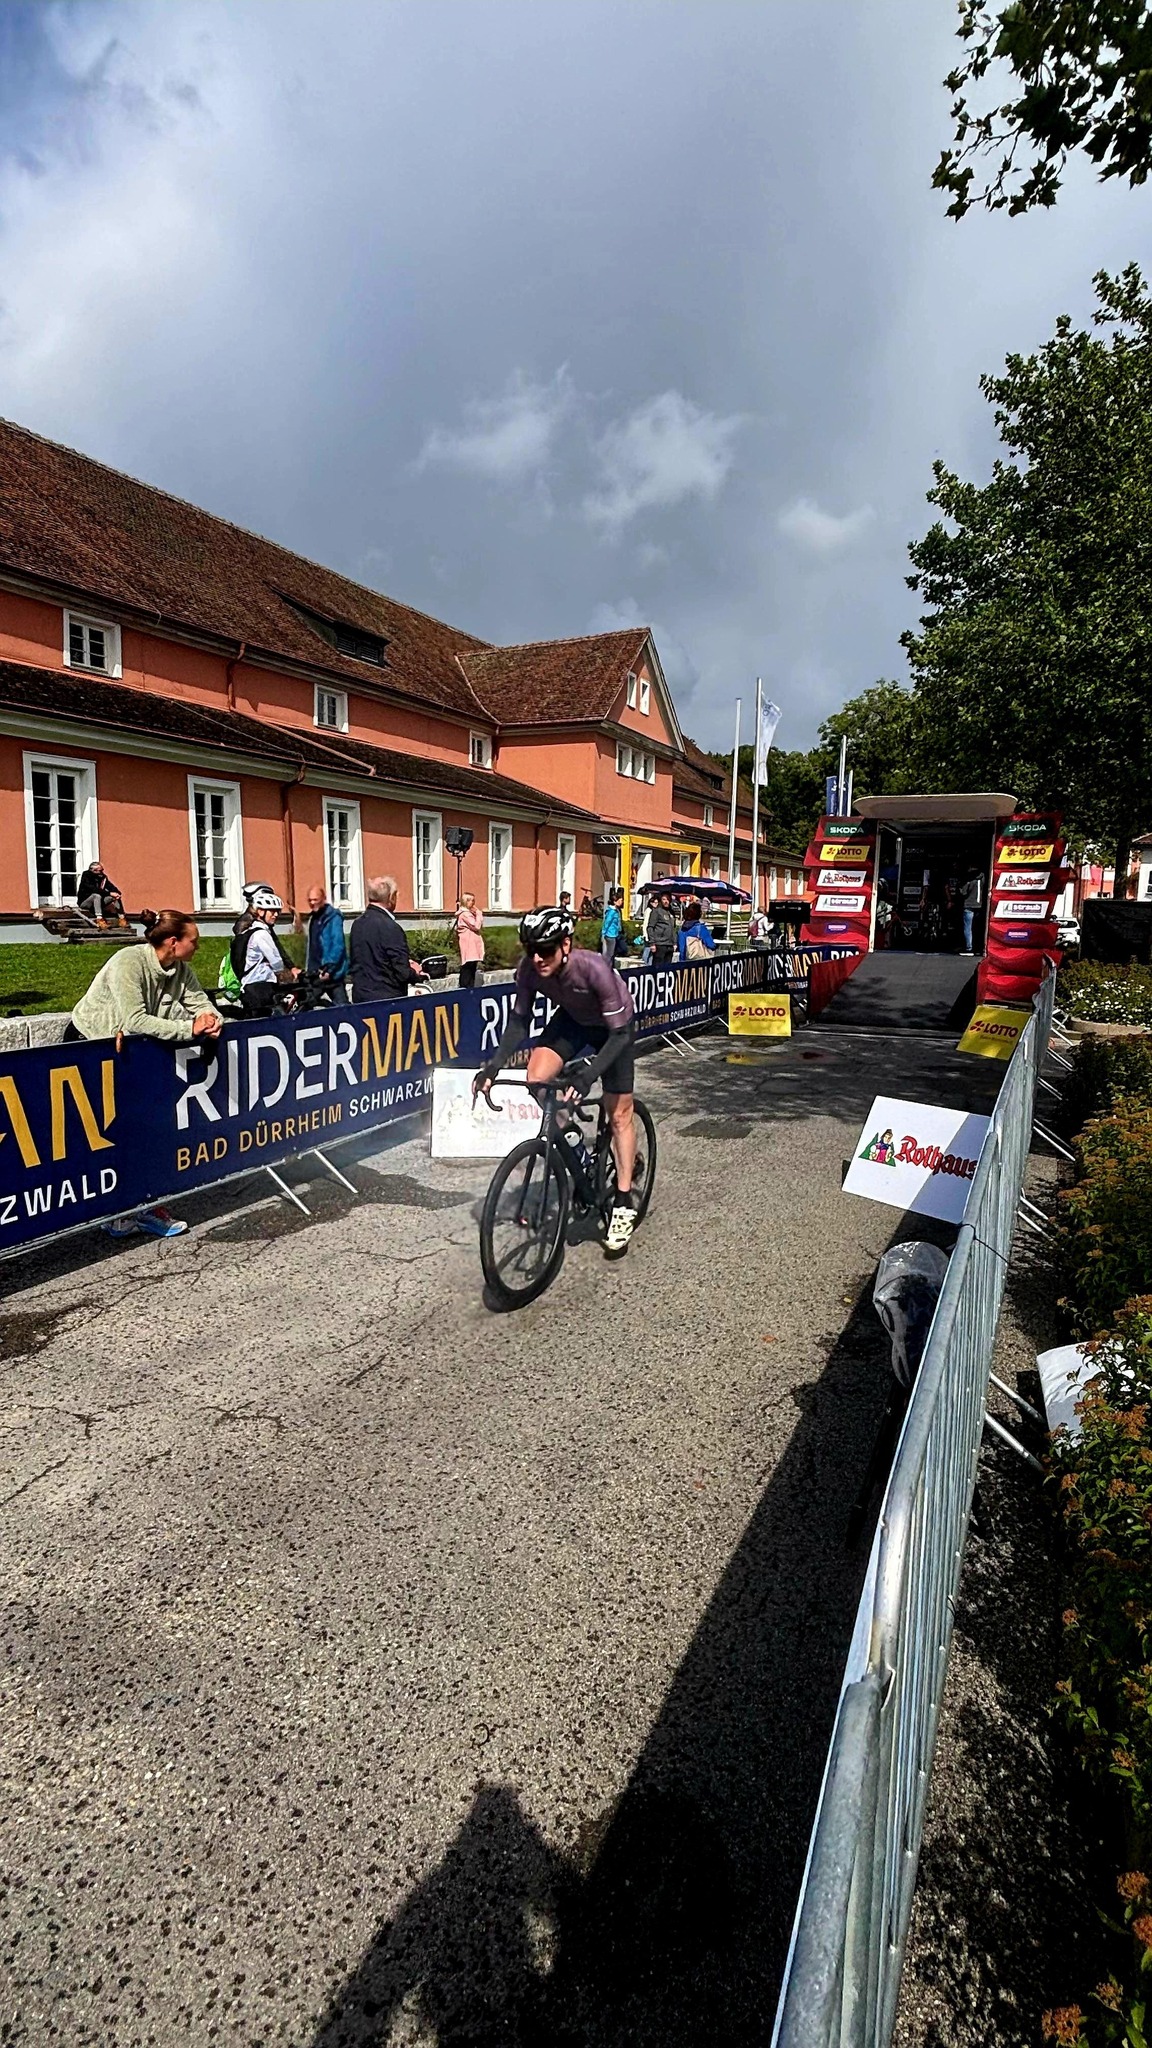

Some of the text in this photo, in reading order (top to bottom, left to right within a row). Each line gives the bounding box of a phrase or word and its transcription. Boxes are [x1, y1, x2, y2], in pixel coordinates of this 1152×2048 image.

[837, 848, 862, 856] LOTTO
[1019, 847, 1046, 856] LOTTO
[628, 965, 708, 1014] RIDERMAN
[713, 955, 764, 995] RIDERMAN
[748, 1006, 786, 1017] LOTTO
[983, 1022, 1019, 1038] LOTTO
[175, 1003, 459, 1131] RIDERMAN
[176, 1136, 229, 1172] BAD
[238, 1102, 343, 1152] DÜRRHEIM
[894, 1134, 978, 1181] Rothaus
